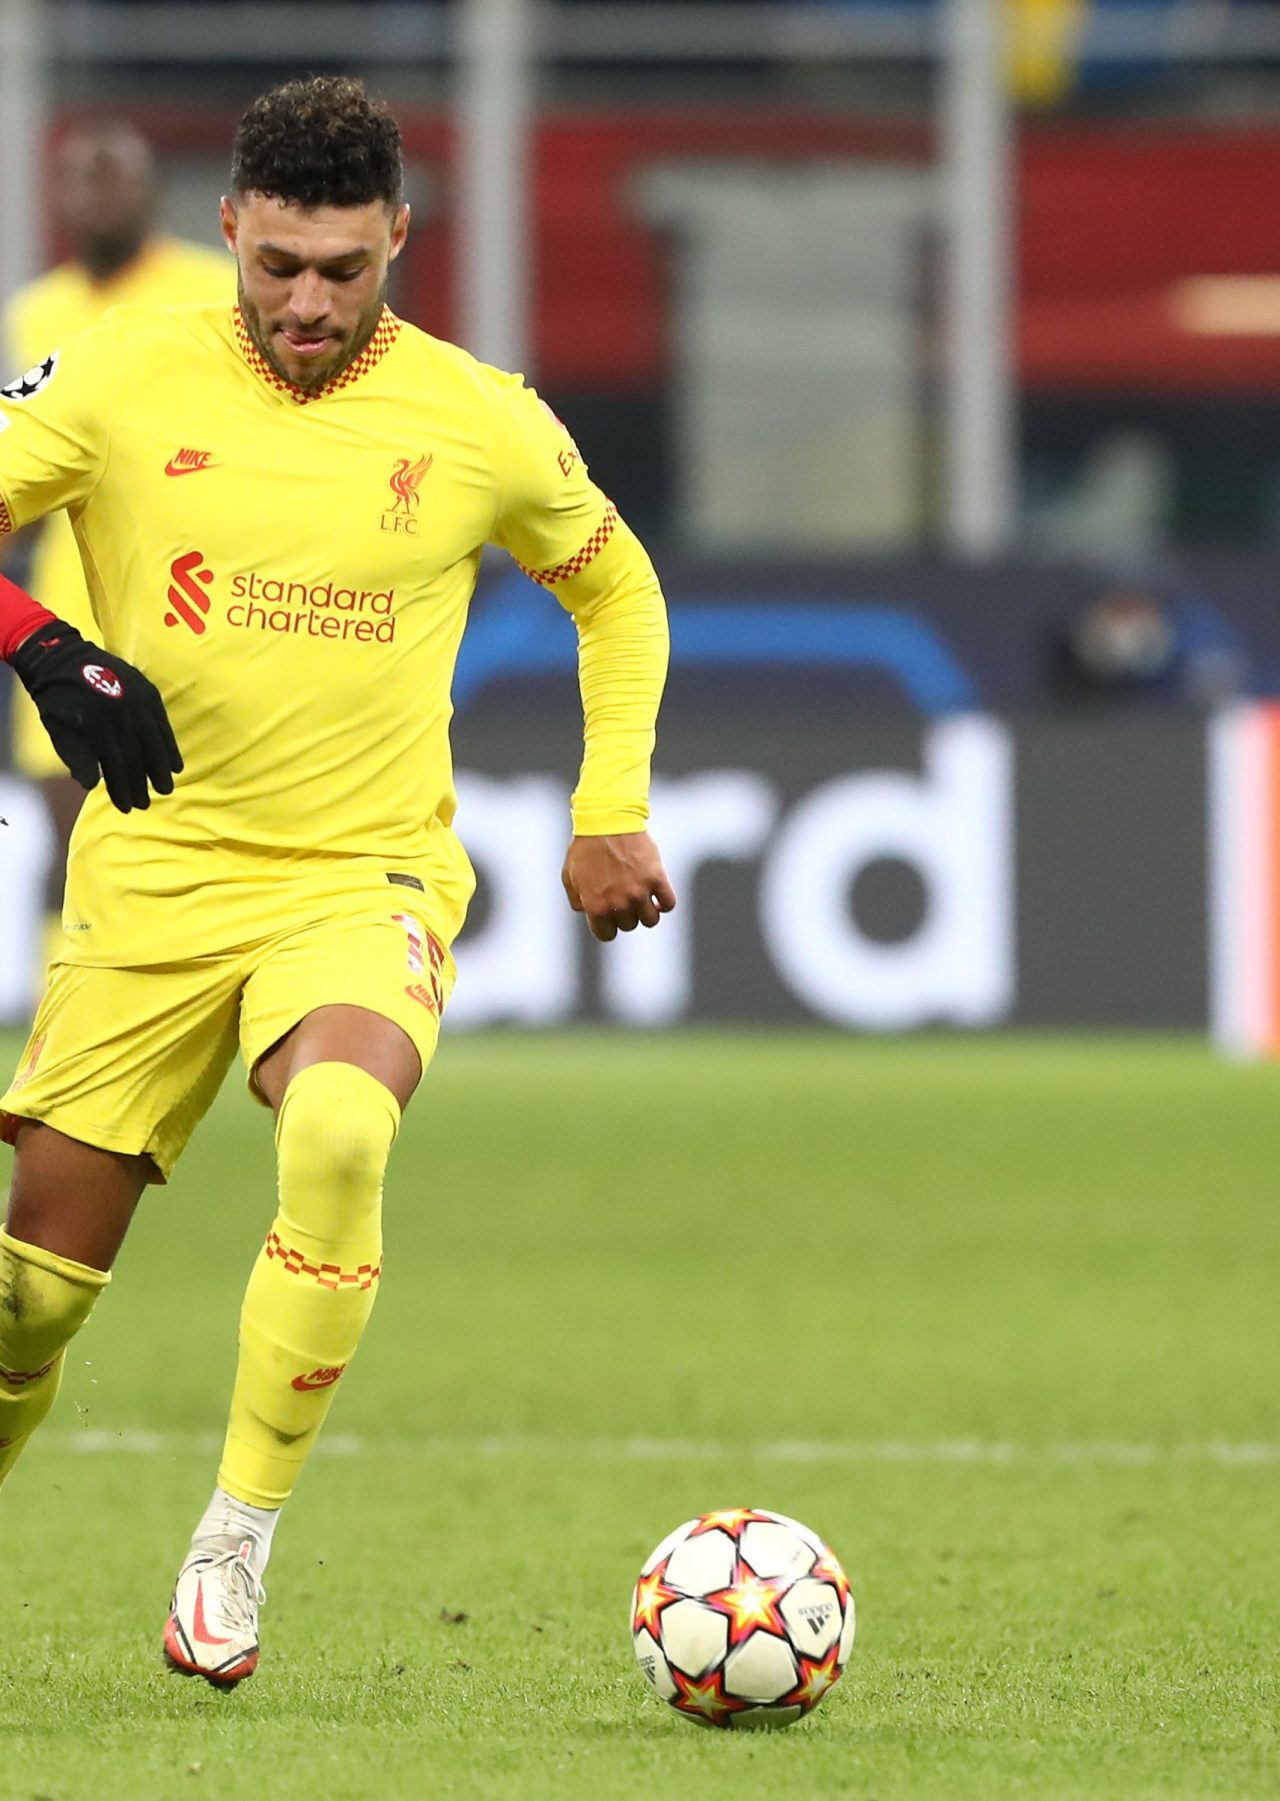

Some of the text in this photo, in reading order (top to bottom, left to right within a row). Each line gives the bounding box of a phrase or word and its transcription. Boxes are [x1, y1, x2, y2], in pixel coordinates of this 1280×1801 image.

[174, 448, 211, 468] NIKE
[230, 572, 394, 615] standard
[227, 602, 396, 643] chartered
